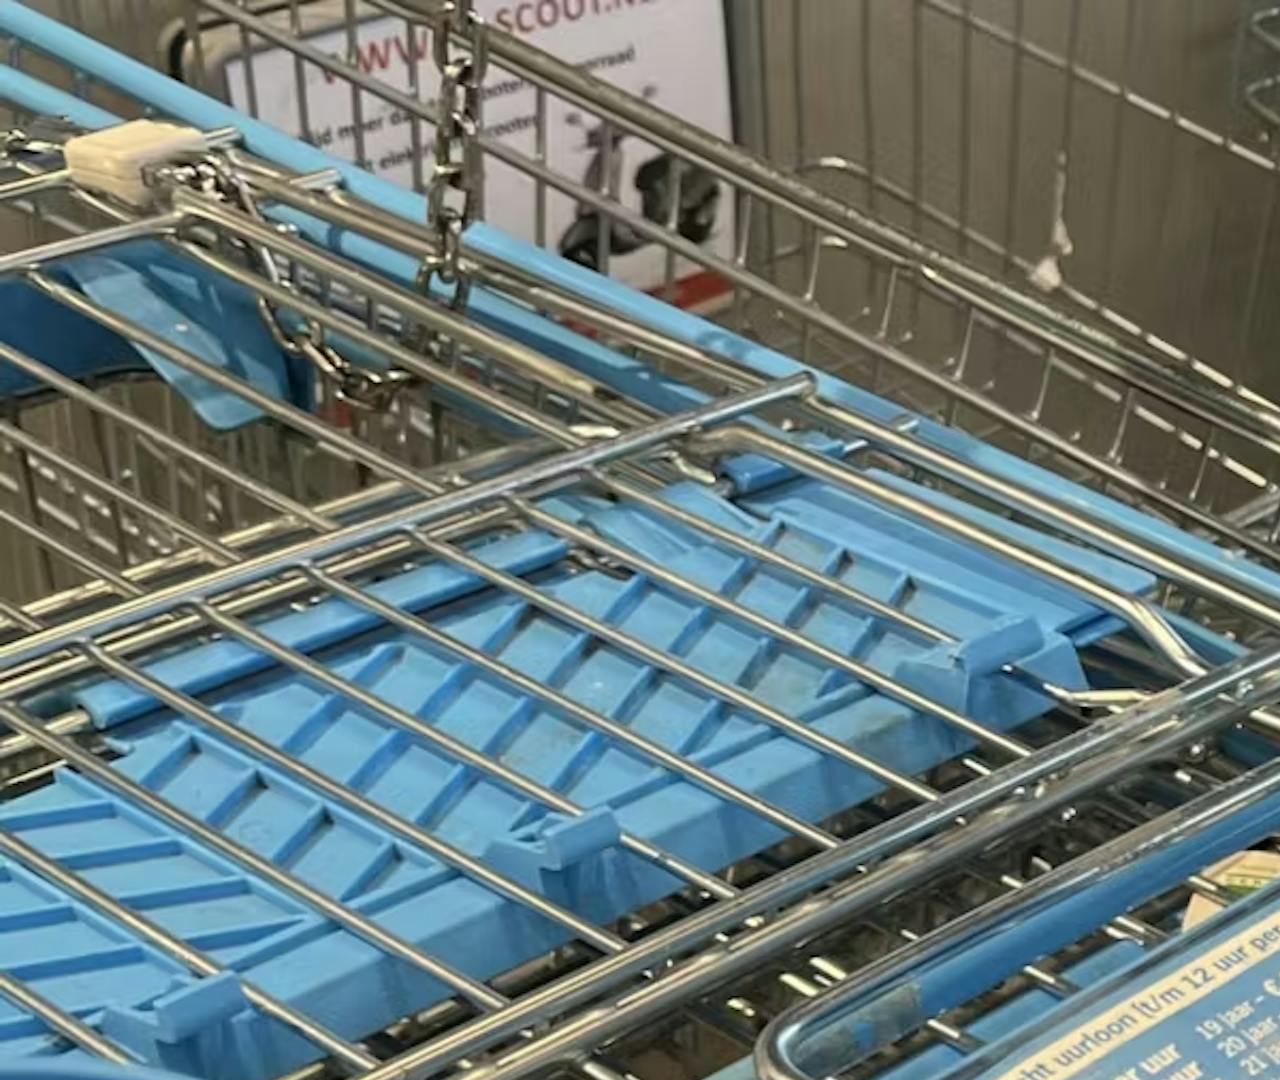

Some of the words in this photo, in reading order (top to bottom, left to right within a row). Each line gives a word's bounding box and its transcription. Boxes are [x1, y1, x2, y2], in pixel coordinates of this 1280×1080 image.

[1054, 1013, 1138, 1067] uurloon
[1181, 967, 1210, 1000] 12
[1213, 946, 1249, 975] uur
[1195, 1018, 1223, 1040] 19
[1220, 998, 1254, 1028] jaar
[1217, 1035, 1246, 1057] 20
[1244, 1015, 1279, 1045] jaar
[1139, 1043, 1182, 1075] uur
[1239, 1055, 1267, 1077] 21
